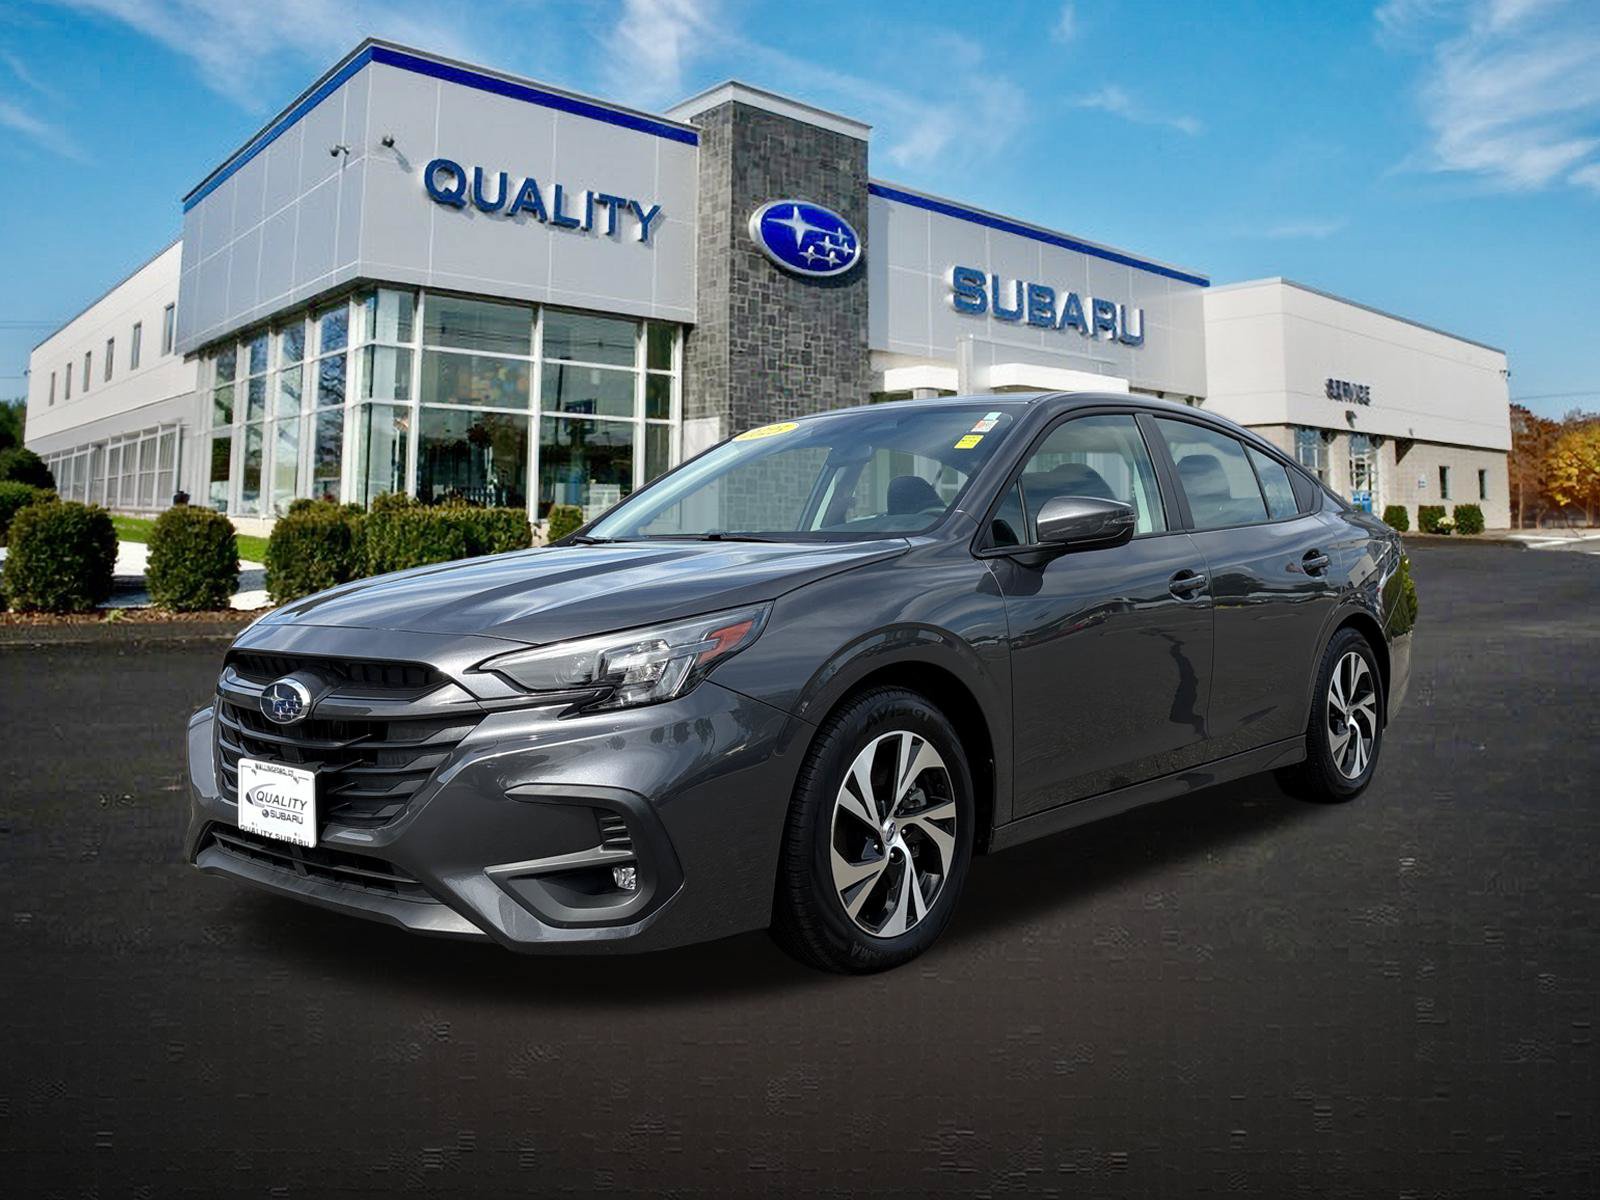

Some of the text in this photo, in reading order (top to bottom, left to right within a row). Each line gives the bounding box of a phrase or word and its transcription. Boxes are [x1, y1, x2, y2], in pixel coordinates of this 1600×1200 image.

[423, 158, 662, 242] QUALITY
[947, 265, 1144, 346] SUBARU
[1323, 378, 1371, 406] SERVICE
[256, 790, 308, 811] QUALITY
[269, 809, 304, 825] SUBARU
[239, 825, 310, 847] QUALITY SUBARU
